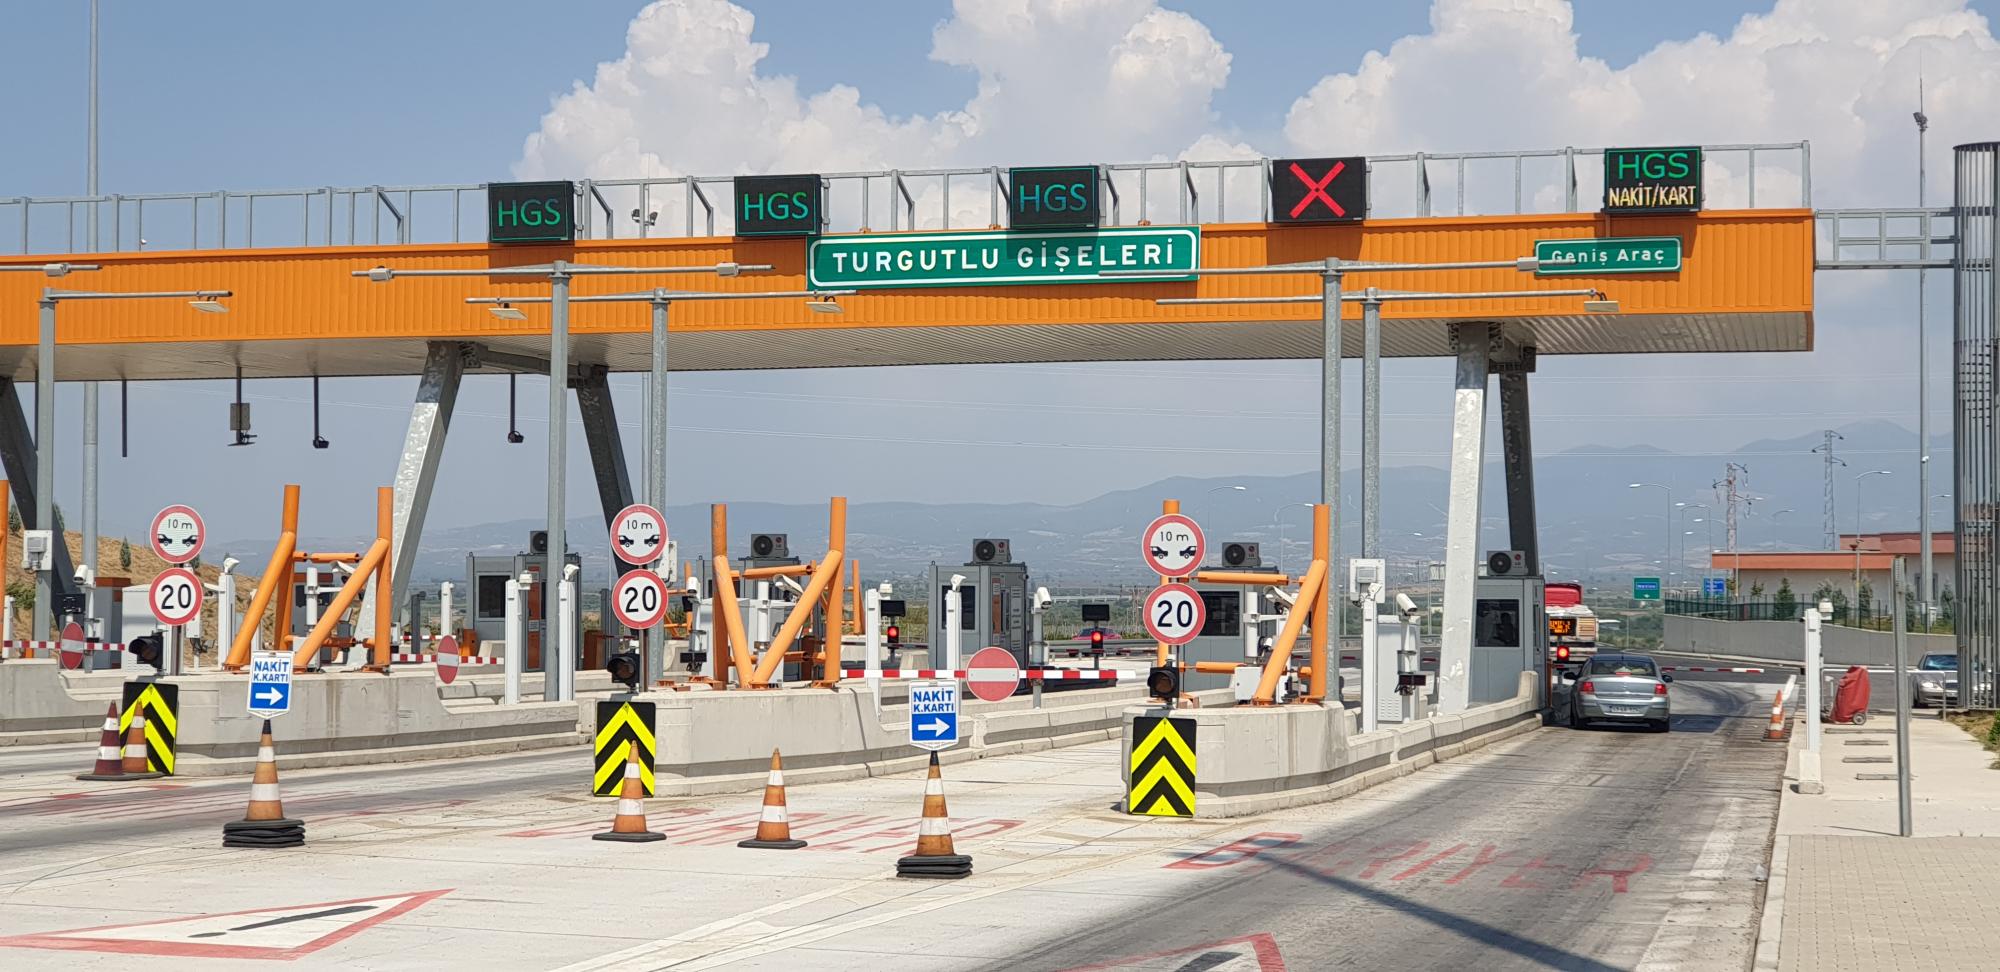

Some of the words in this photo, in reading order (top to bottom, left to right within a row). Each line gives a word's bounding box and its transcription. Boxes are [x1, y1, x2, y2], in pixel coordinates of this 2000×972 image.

[1618, 152, 1690, 180] HGS
[743, 191, 809, 221] HGS
[1018, 183, 1088, 213] HGS
[1608, 181, 1697, 207] NAKİT/KART
[497, 198, 562, 227] HGS
[832, 248, 999, 273] TURGUTLU
[1017, 237, 1174, 273] GİŞELERİ
[1551, 248, 1608, 266] Geniş
[1616, 248, 1665, 265] Araç
[167, 518, 179, 529] 10
[181, 521, 193, 530] m
[627, 519, 638, 530] 10
[641, 521, 653, 530] m
[1160, 531, 1173, 542] 10
[1176, 534, 1189, 542] m
[160, 583, 192, 610] 20
[624, 585, 657, 613] 20
[1157, 600, 1193, 628] 20
[253, 673, 289, 682] K.KARTI
[254, 658, 290, 673] NAKİT
[913, 687, 954, 703] NAKİT
[913, 703, 954, 713] K.KARTI
